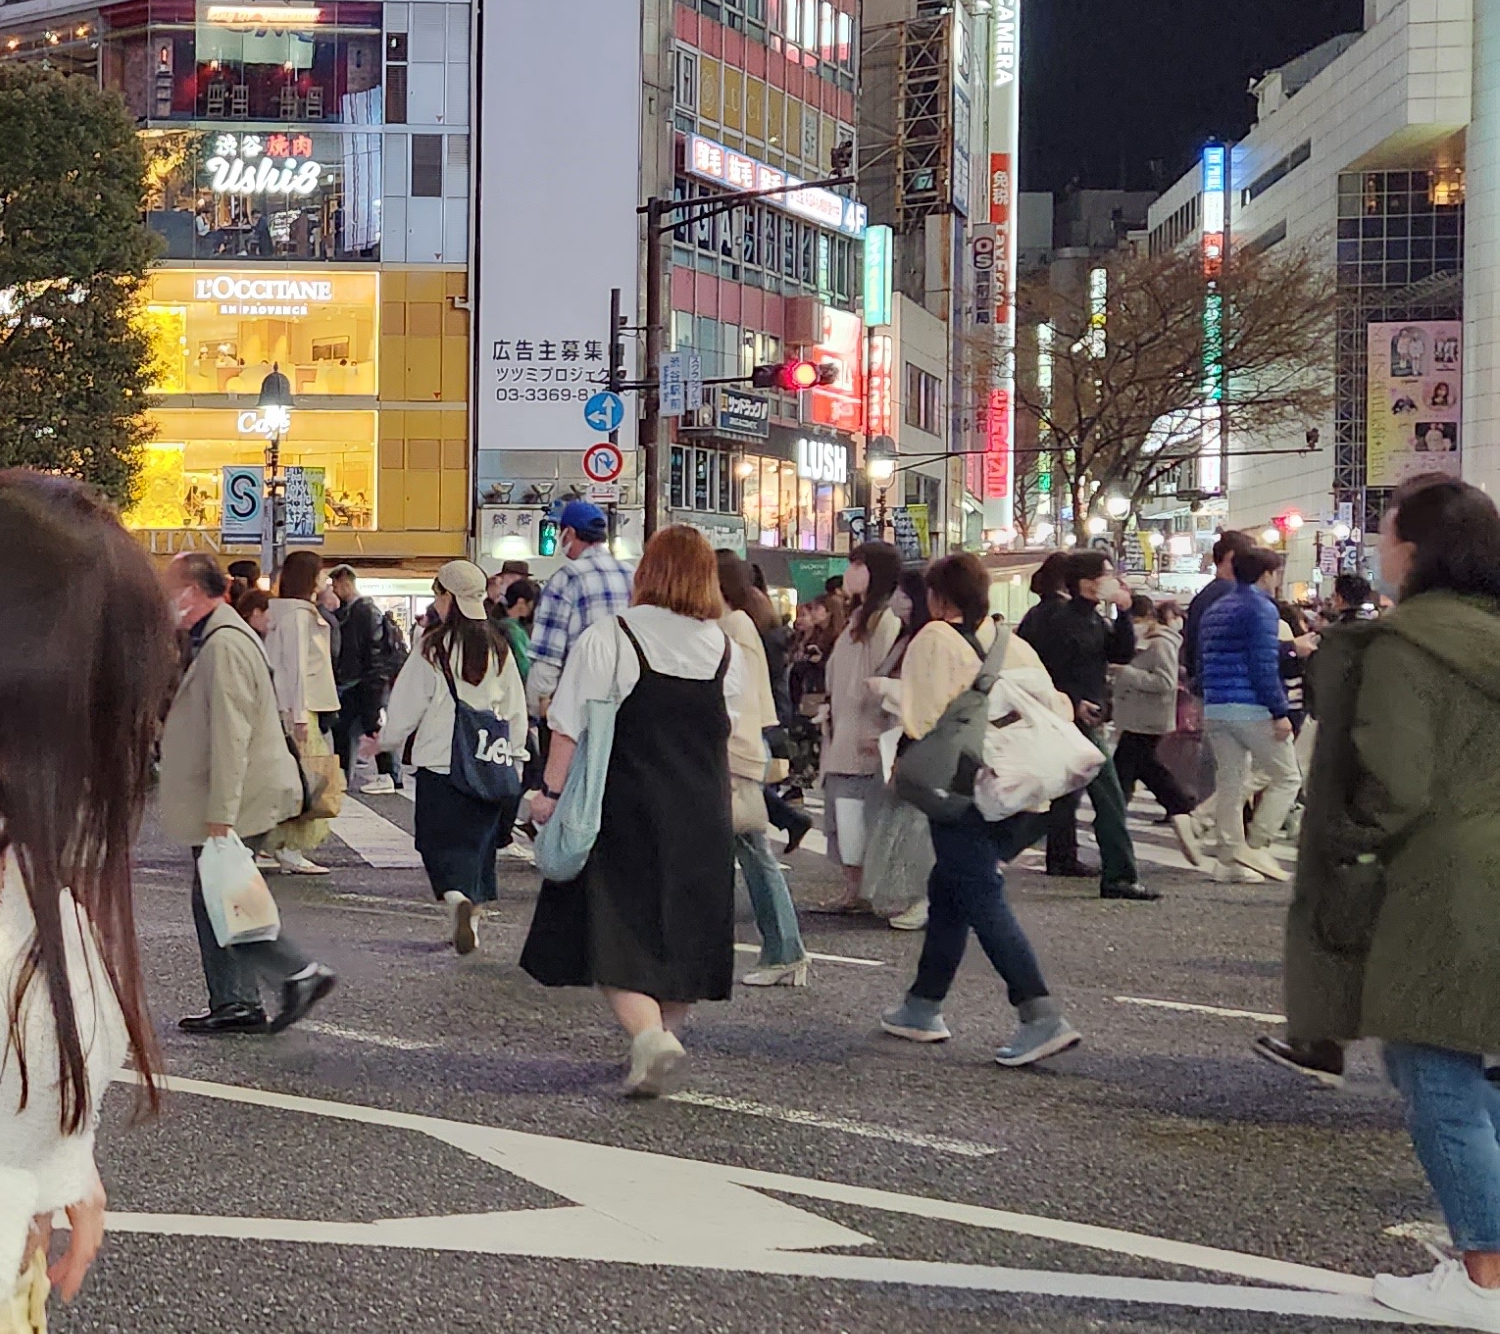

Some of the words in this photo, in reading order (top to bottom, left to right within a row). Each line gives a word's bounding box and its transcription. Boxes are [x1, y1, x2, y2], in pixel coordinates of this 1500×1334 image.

[216, 134, 313, 158] 渋谷焼肉
[205, 157, 321, 195] Ushi8
[844, 201, 867, 234] 4F
[195, 275, 333, 302] L'OCCITANE
[492, 340, 603, 362] 広告主募集
[496, 367, 610, 384] ツツミプロジェク
[496, 388, 597, 402] 03-3369-8
[799, 438, 848, 484] LUSH
